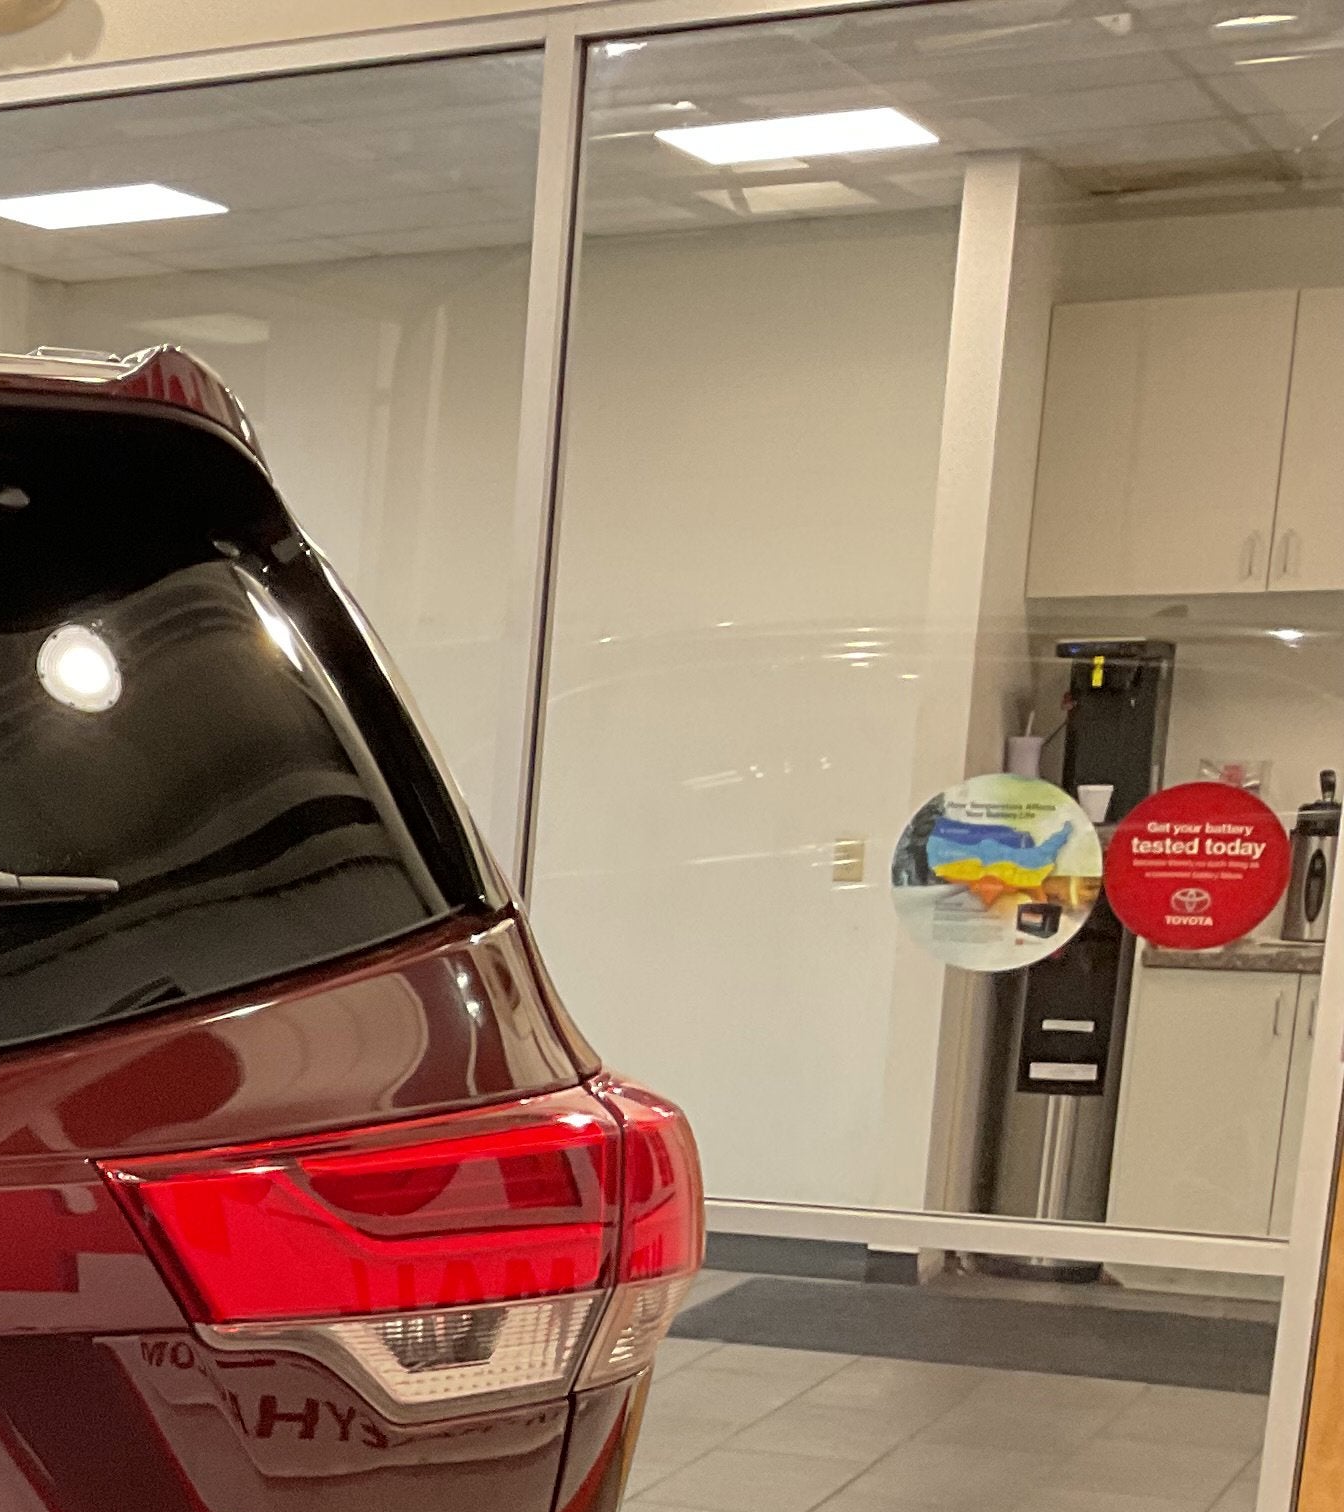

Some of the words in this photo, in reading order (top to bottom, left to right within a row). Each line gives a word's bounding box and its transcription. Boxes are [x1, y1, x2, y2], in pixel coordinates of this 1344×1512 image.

[1147, 822, 1170, 834] Get
[1173, 824, 1203, 836] your
[1205, 822, 1254, 837] battery
[1132, 837, 1200, 856] tested
[1205, 838, 1267, 860] today
[1164, 915, 1214, 926] TOYOTA
